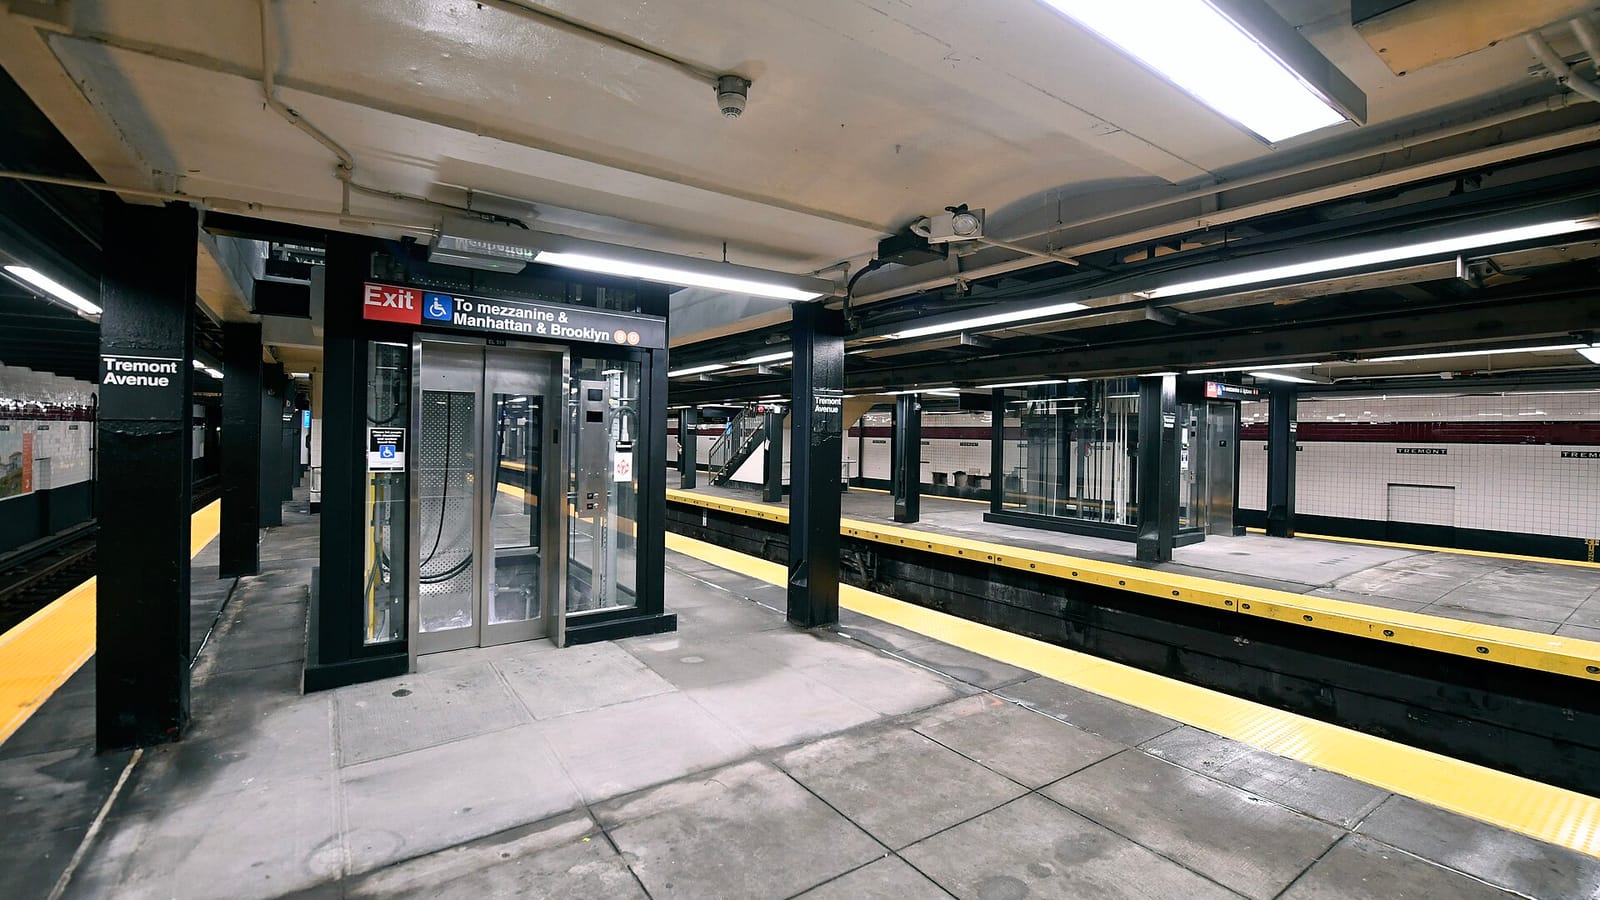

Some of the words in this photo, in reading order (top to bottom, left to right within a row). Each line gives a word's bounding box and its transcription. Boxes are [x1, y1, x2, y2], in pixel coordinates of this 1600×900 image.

[364, 285, 414, 310] Exit
[454, 298, 473, 311] To
[478, 303, 555, 322] mezzanine
[558, 312, 568, 324] &
[454, 312, 532, 332] Manhattan
[536, 323, 547, 335] &
[551, 323, 610, 342] Brooklyn
[103, 358, 177, 373] Tremont
[103, 372, 169, 386] Avenue
[815, 397, 841, 405] Tremont
[815, 405, 839, 413] Avenue
